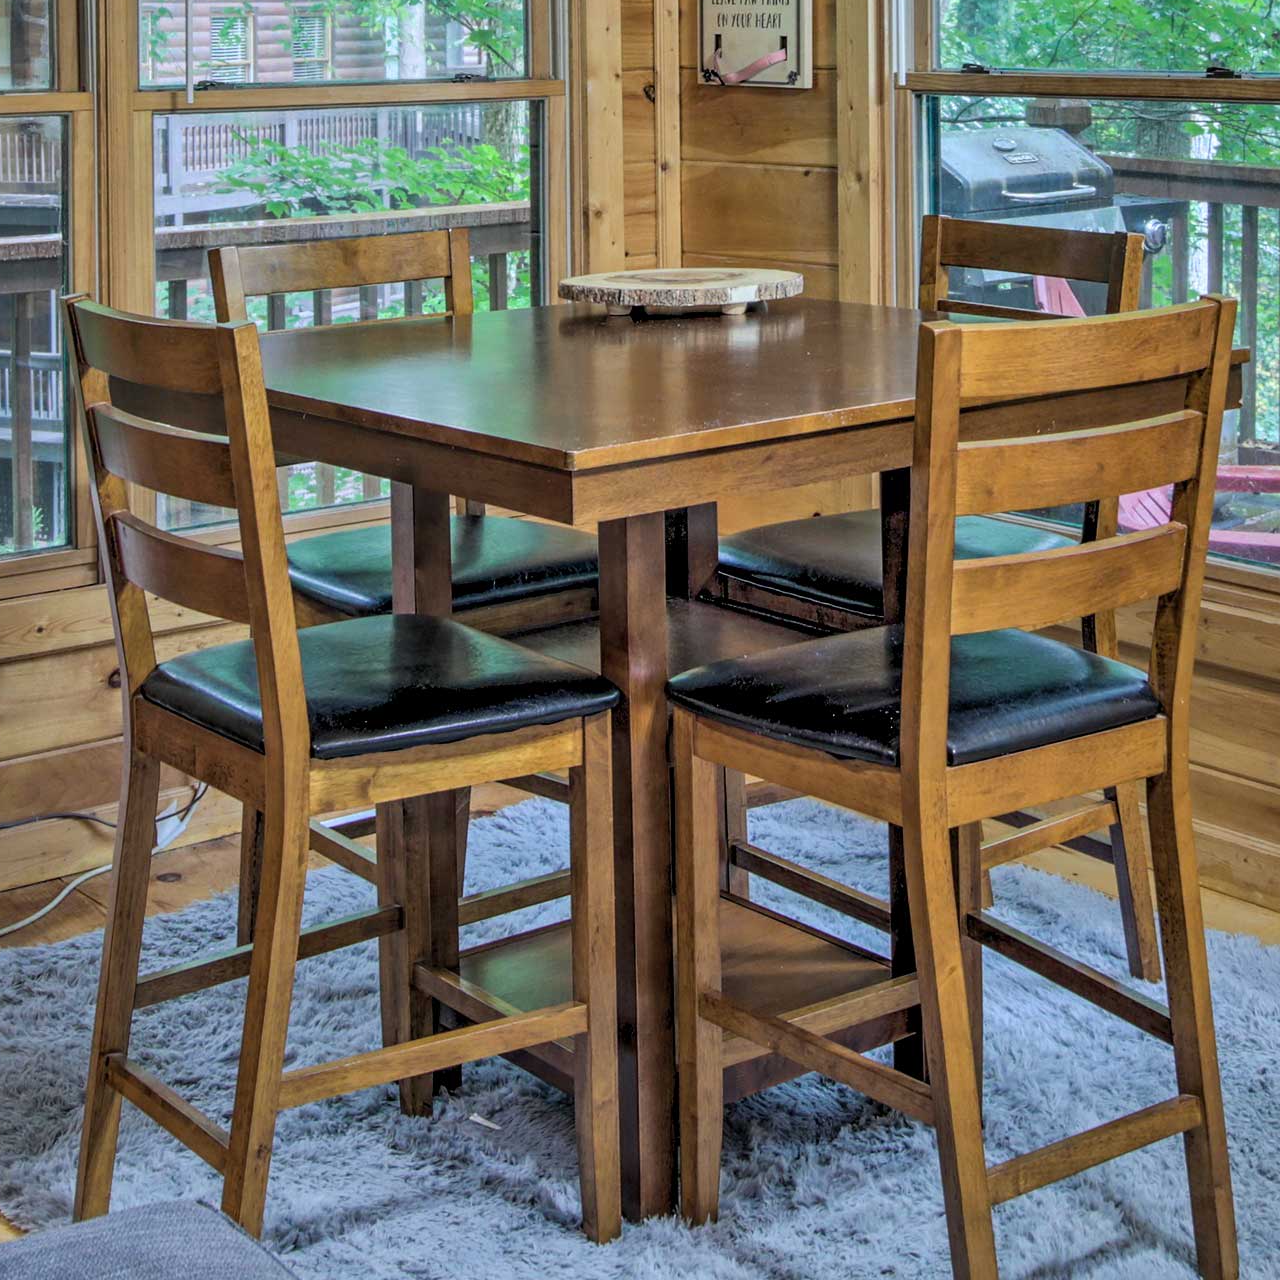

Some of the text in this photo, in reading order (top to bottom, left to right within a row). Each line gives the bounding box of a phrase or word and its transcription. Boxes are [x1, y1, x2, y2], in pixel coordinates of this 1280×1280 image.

[717, 13, 782, 28] ON YOUR HEART
